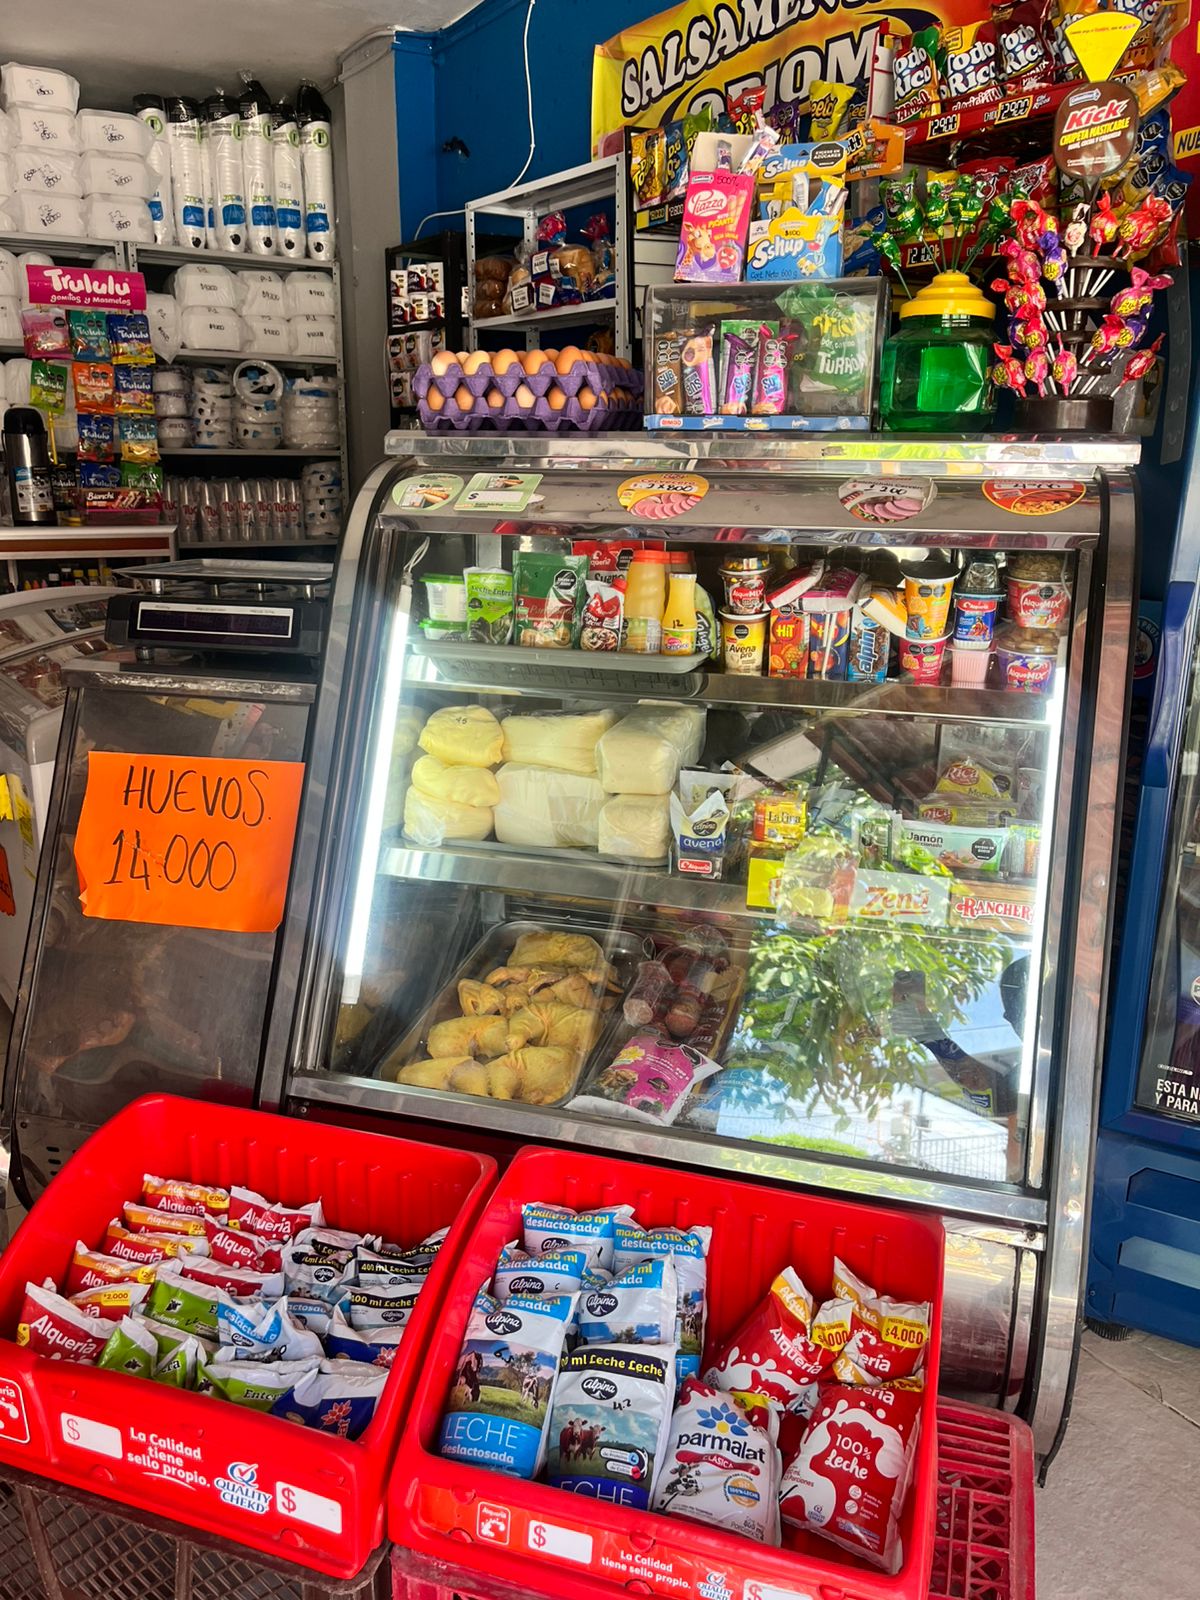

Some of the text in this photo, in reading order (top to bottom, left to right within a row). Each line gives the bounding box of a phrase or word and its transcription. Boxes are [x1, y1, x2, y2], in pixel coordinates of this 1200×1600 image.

[1063, 99, 1130, 134] Kick
[751, 235, 804, 270] Sshup
[43, 268, 131, 297] Trululu
[118, 329, 149, 339] Trululu
[120, 380, 151, 390] Trululu
[87, 492, 115, 501] Bianchi
[729, 644, 756, 654] Avena
[856, 630, 879, 674] alpin
[683, 837, 723, 849] avena
[906, 831, 944, 844] Jamón
[1156, 1078, 1200, 1101] ESTA N
[1154, 1092, 1198, 1115] Y PARA
[525, 1216, 600, 1234] deslactosada
[110, 1240, 163, 1263] Alquería
[563, 1253, 578, 1264] ml
[637, 1263, 653, 1275] ml
[510, 1278, 543, 1291] alpina
[587, 1296, 616, 1309] alpina
[30, 1314, 97, 1354] Alquería
[885, 1327, 924, 1346] $4.000
[571, 1355, 664, 1377] ml Leche Leche
[582, 1379, 617, 1394] alpina
[66, 1418, 81, 1442] $
[444, 1416, 522, 1450] LECHE
[129, 1427, 203, 1460] La Calidad
[441, 1442, 515, 1465] deslactosada
[676, 1431, 766, 1464] parmalat
[835, 1433, 873, 1462] 100%
[147, 1446, 184, 1467] tiene
[824, 1448, 869, 1481] Leche
[127, 1452, 211, 1488] sello propio.
[215, 1478, 272, 1505] QUALITY
[222, 1491, 266, 1514] CHEKD
[281, 1486, 297, 1514] $
[532, 1524, 548, 1548] $
[601, 1556, 692, 1590] tiene sello propio.
[620, 1550, 674, 1573] La Calidad
